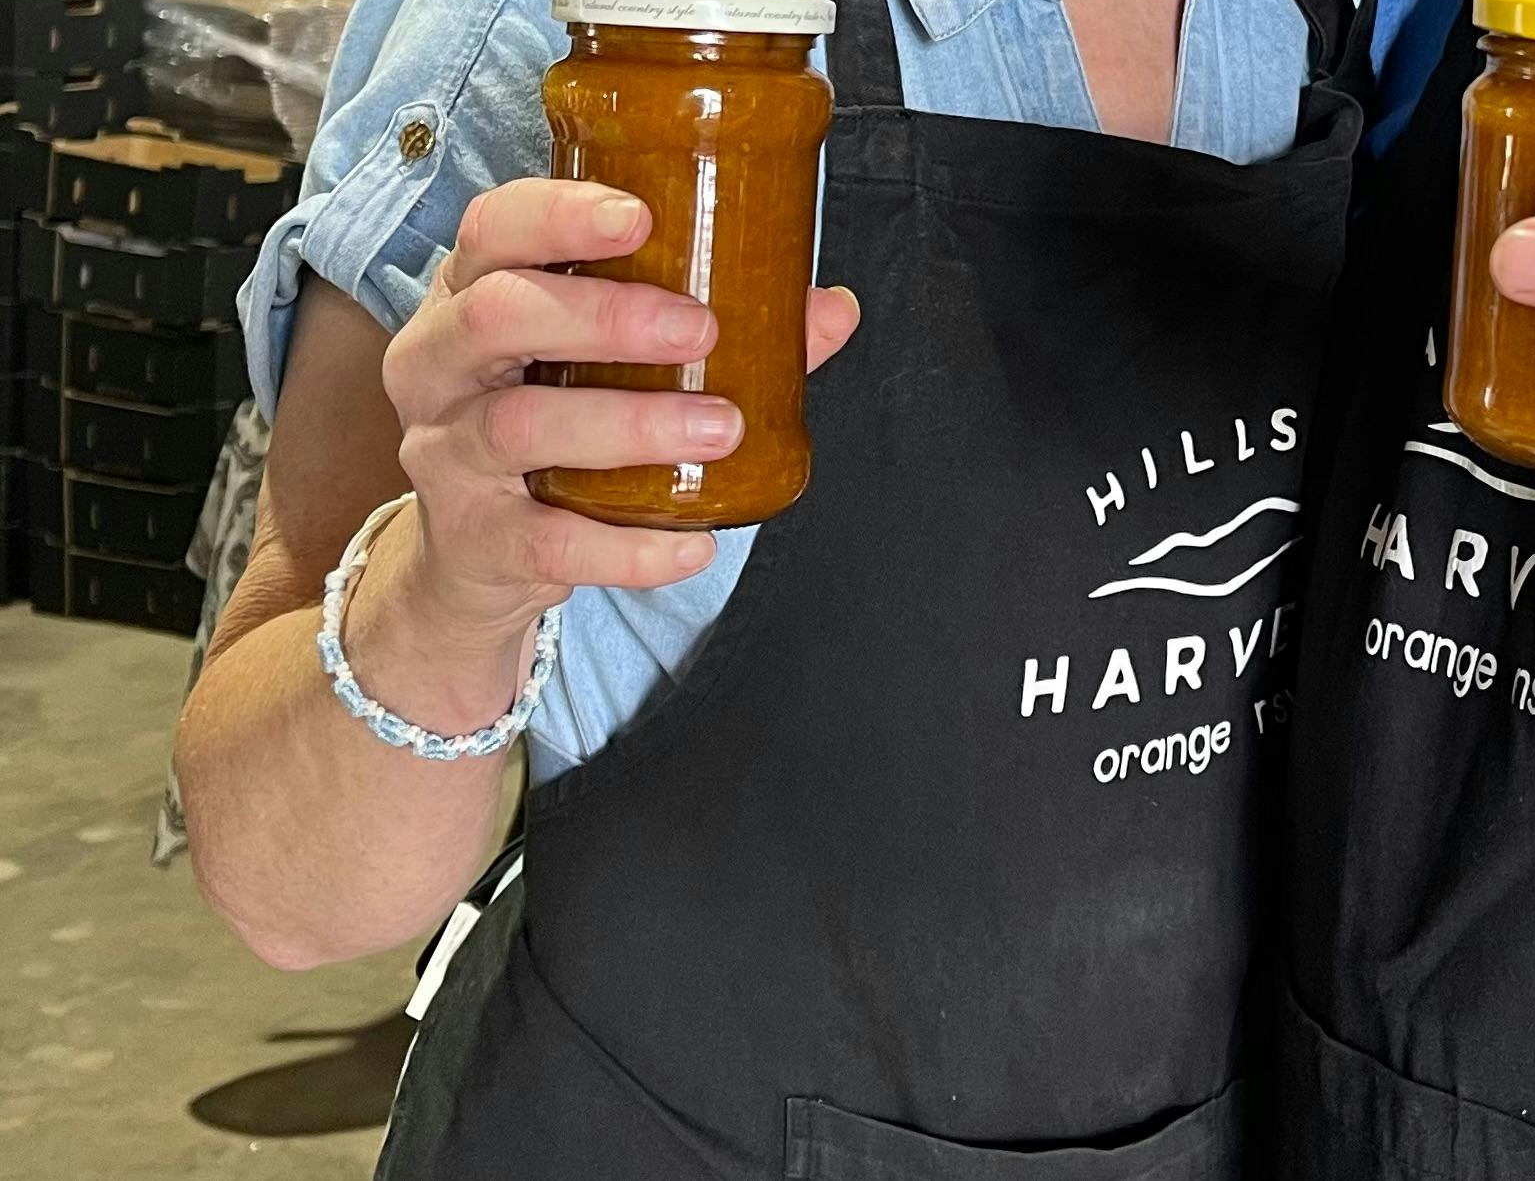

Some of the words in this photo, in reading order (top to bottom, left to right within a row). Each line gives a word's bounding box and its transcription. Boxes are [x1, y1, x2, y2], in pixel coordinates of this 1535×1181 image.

[618, 3, 664, 20] country
[1086, 407, 1297, 526] HILLS
[1020, 603, 1296, 717] HARVE
[1365, 617, 1497, 698] orange
[1092, 720, 1232, 784] orange
